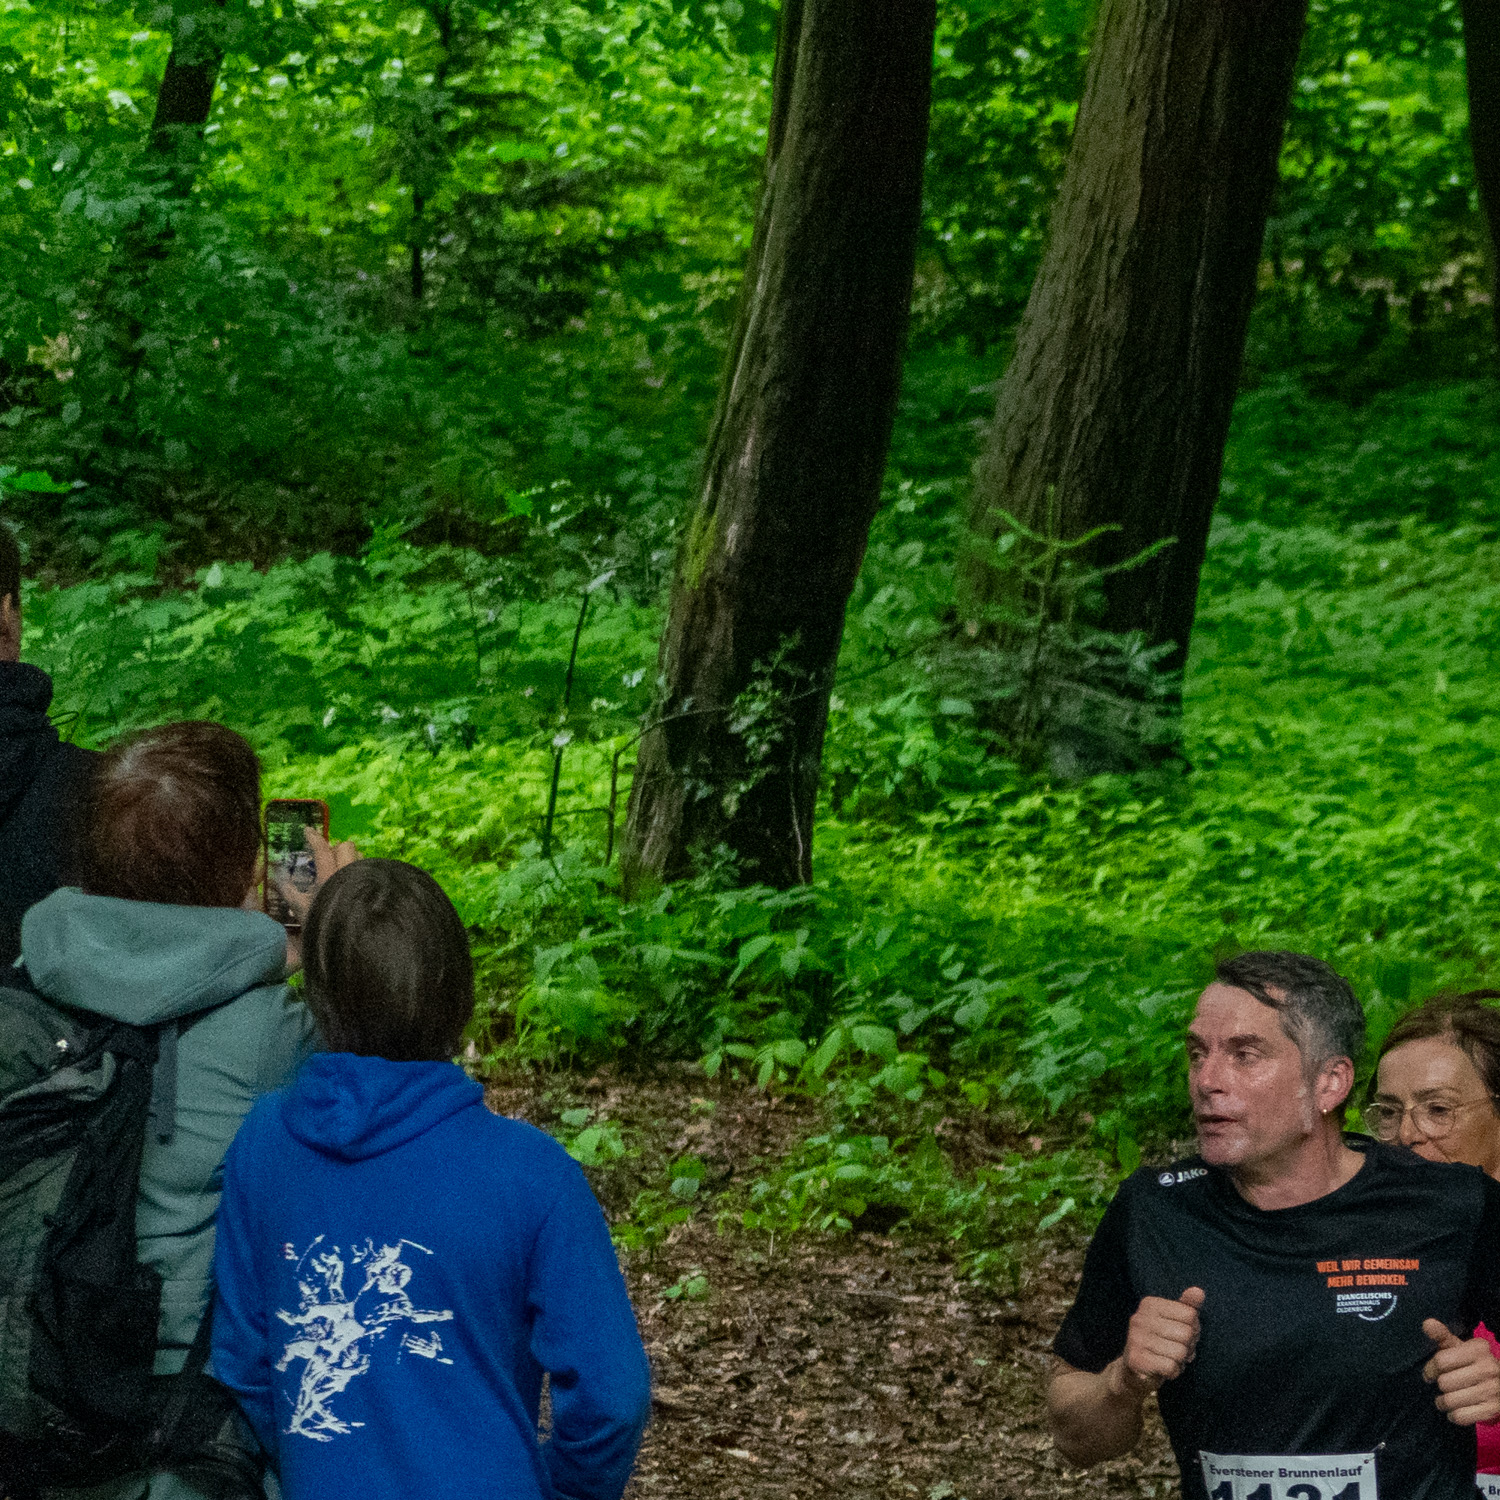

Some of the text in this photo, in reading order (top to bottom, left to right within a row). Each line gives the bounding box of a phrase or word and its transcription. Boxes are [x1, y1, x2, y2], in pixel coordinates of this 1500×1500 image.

[1176, 1168, 1208, 1183] JAKO
[1316, 1258, 1420, 1273] WEIL WIR GEMEINSAM
[1327, 1275, 1354, 1288] MEHR
[1336, 1292, 1392, 1301] EVANGELISCHES
[1210, 1464, 1363, 1478] Everstener Brunnenlauf
